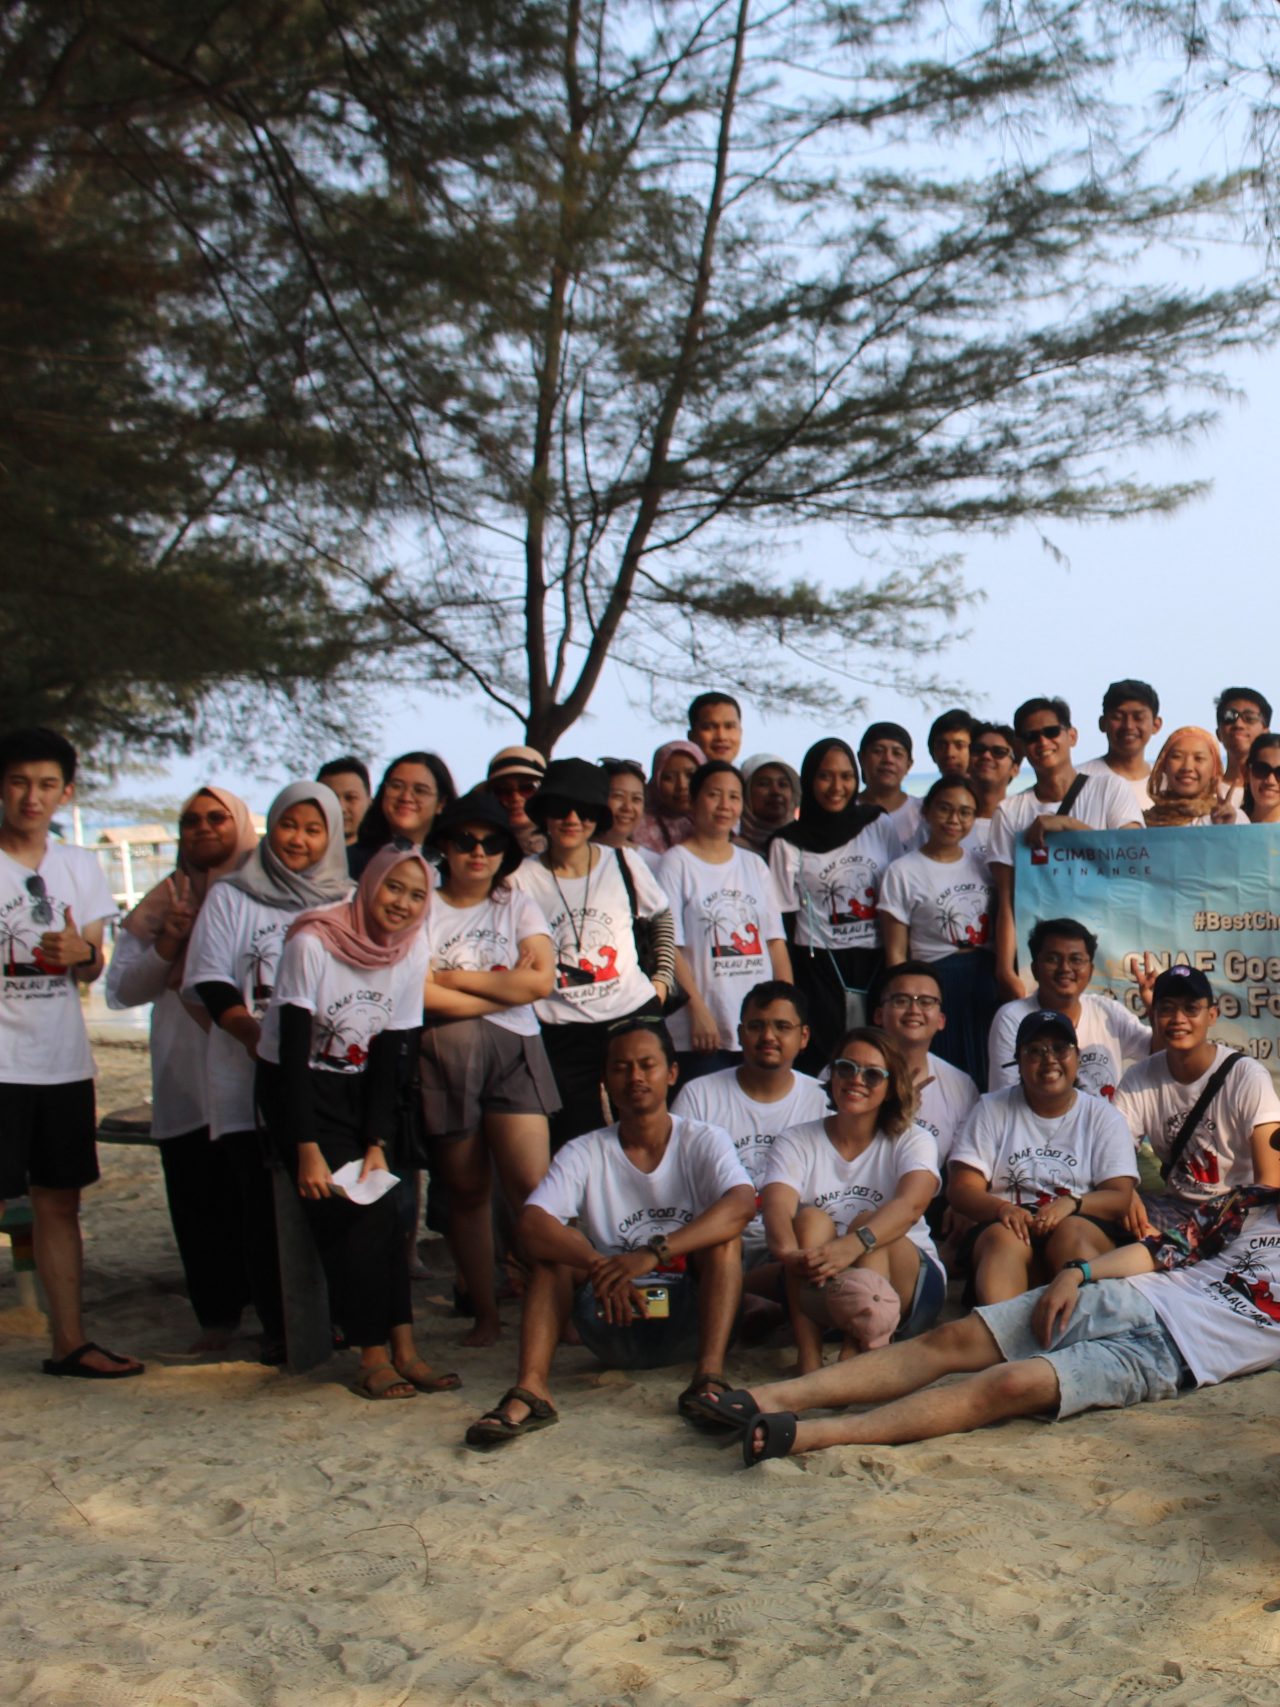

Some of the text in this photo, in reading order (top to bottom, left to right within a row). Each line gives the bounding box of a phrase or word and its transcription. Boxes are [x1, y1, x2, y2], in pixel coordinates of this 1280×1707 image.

[1053, 866, 1151, 876] FINANCE
[1248, 1037, 1273, 1059] 19
[1008, 1147, 1078, 1167] CNAF GOES TO
[814, 1190, 841, 1208] CNAF
[870, 1190, 884, 1202] TO
[619, 1207, 695, 1233] CNAF GOES TO
[1209, 1281, 1247, 1312] PULAU
